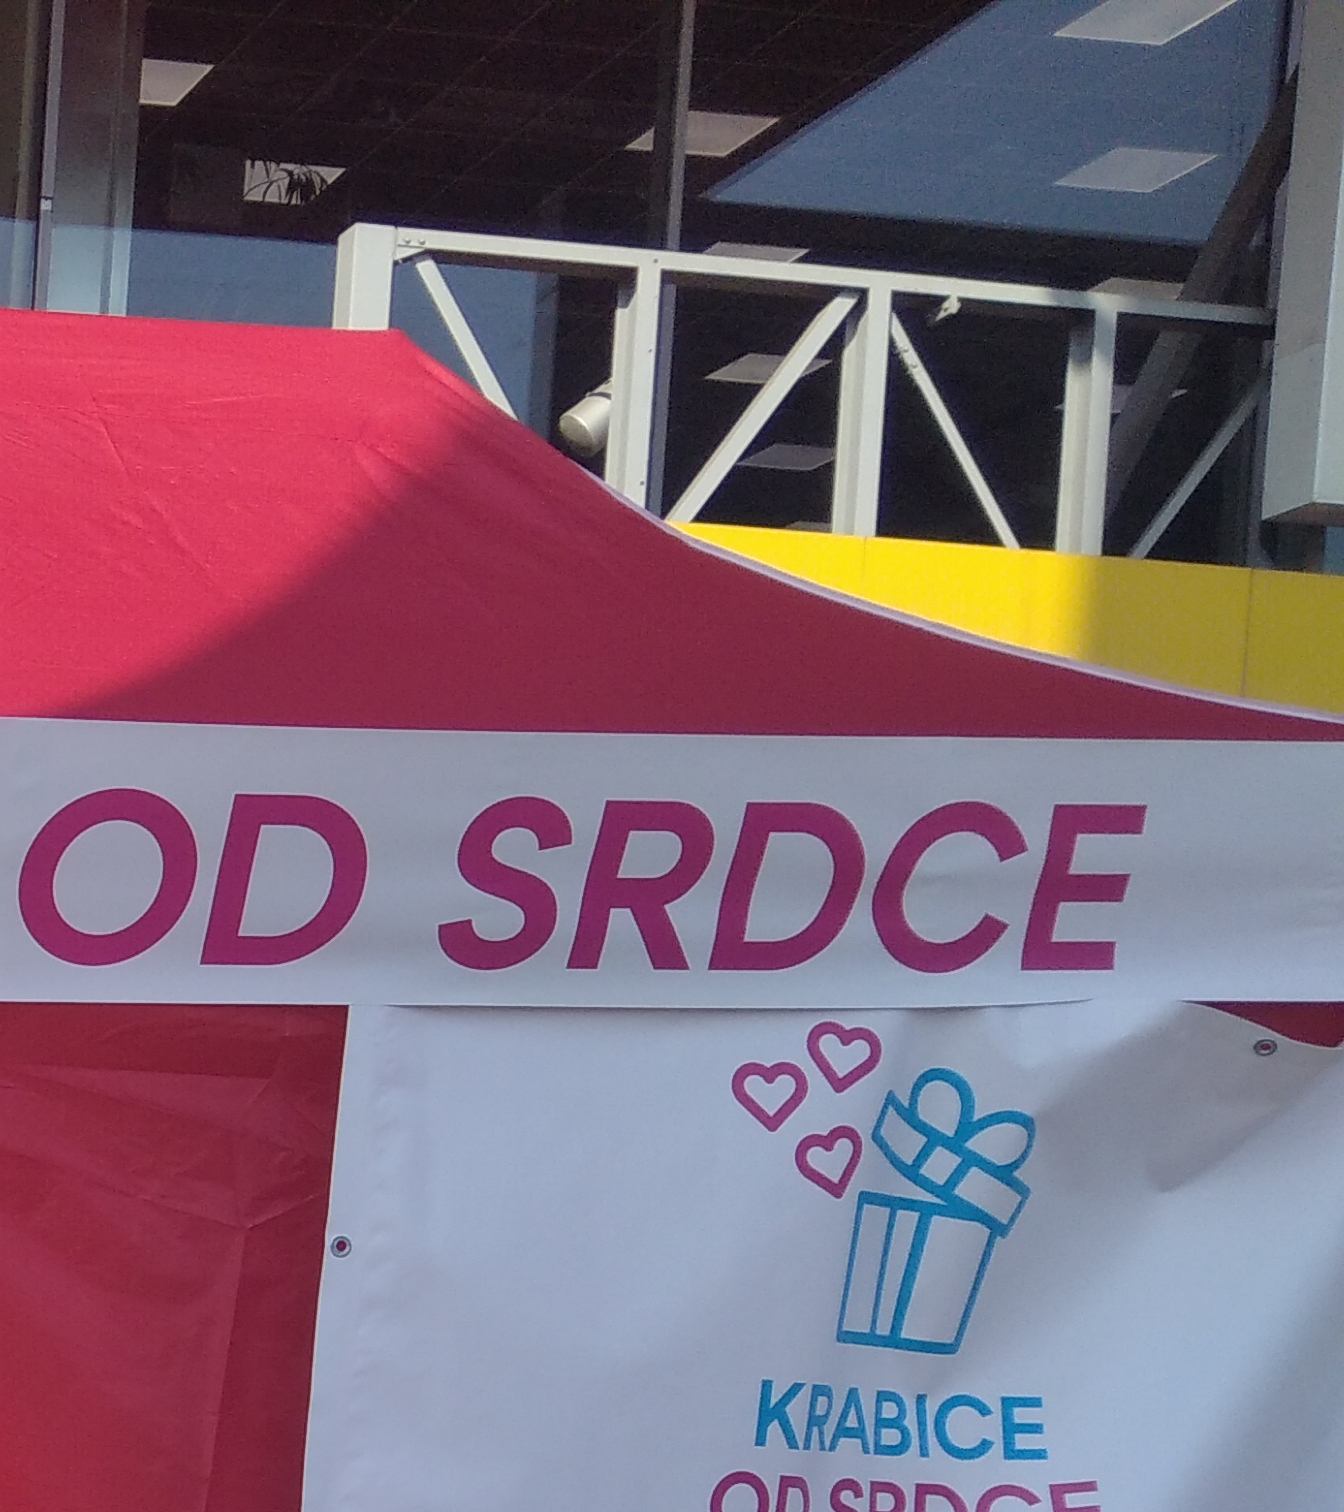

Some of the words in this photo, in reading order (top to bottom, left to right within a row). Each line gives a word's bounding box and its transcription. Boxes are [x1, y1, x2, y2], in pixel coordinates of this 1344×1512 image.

[17, 786, 368, 967] OD
[437, 795, 1148, 974] SRDCE
[753, 1378, 1049, 1462] KRABICE
